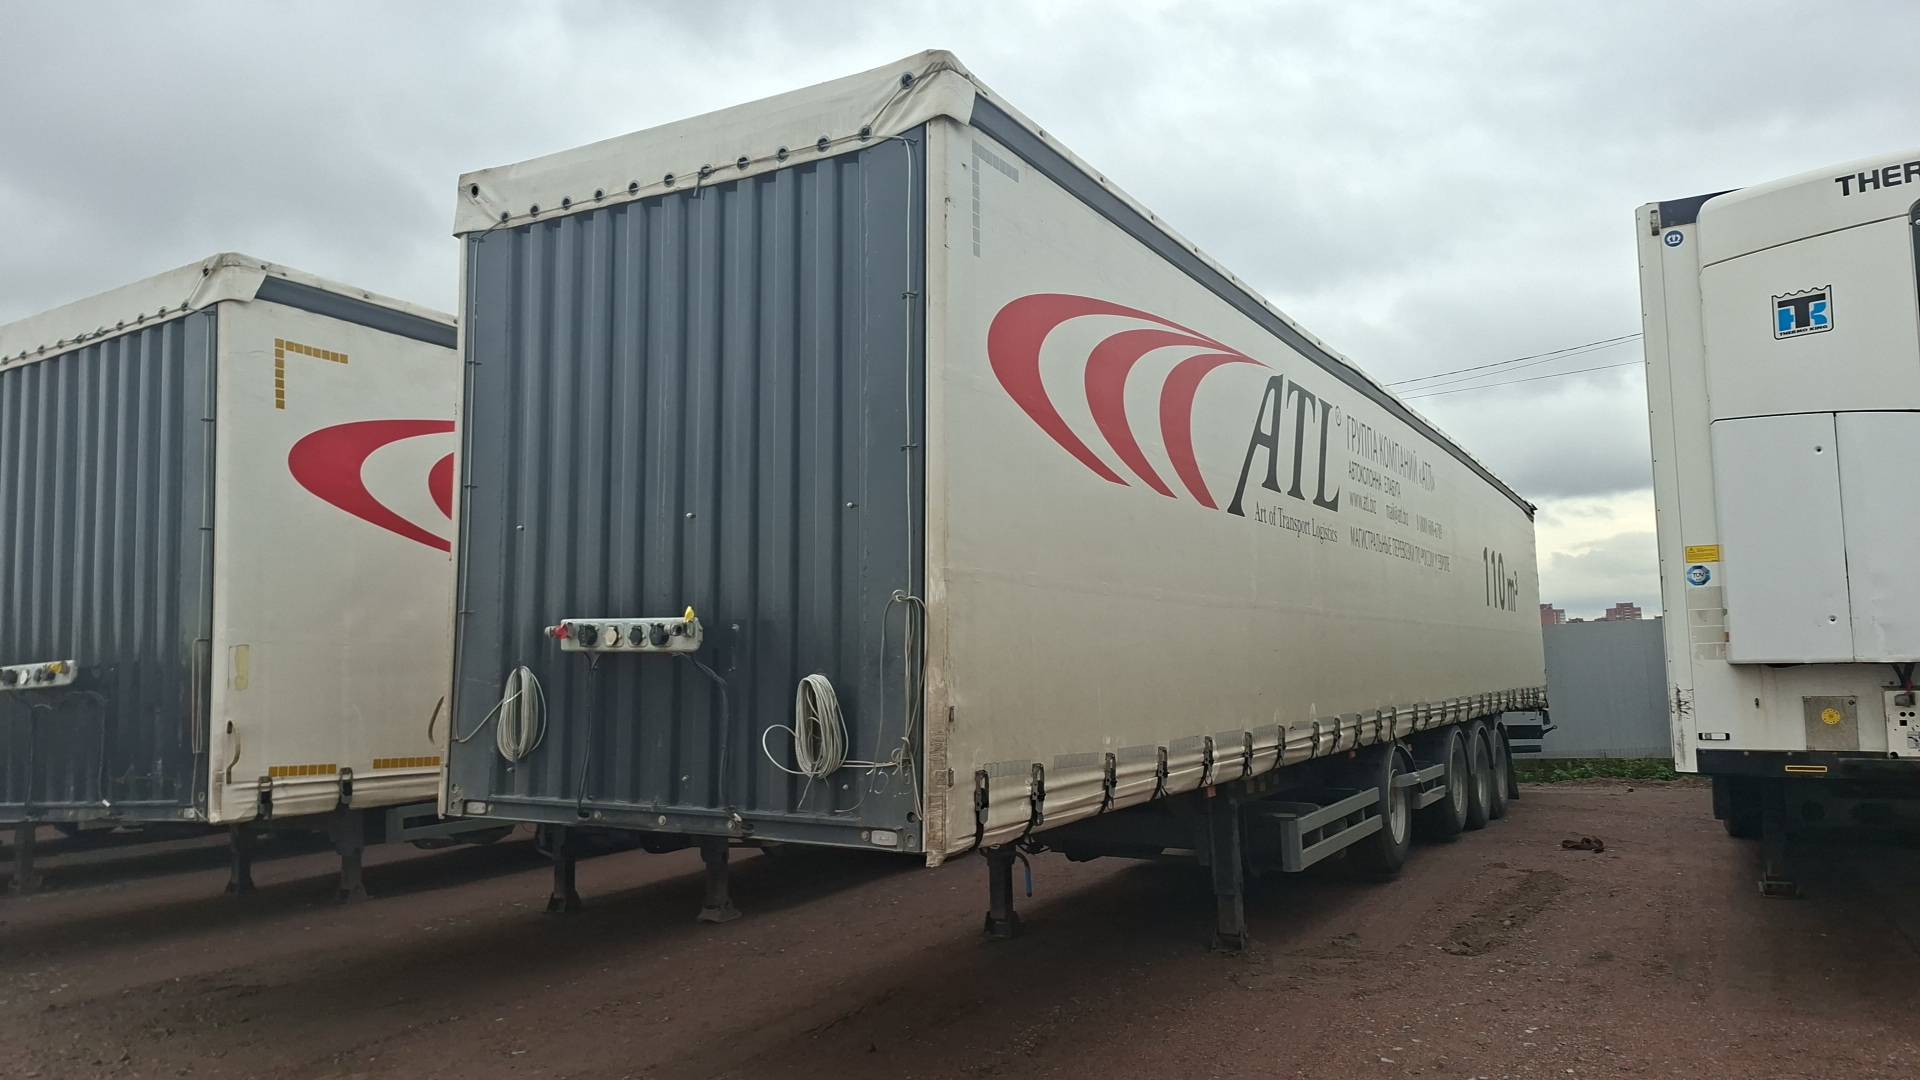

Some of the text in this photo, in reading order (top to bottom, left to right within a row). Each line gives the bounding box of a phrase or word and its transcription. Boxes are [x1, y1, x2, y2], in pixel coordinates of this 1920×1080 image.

[1835, 161, 1920, 196] THER
[1227, 374, 1340, 517] ATL
[1346, 414, 1378, 464] ГРУППА
[1379, 432, 1418, 484] КОМПАНИЙ
[1254, 500, 1338, 544] Art of Transport Logistics
